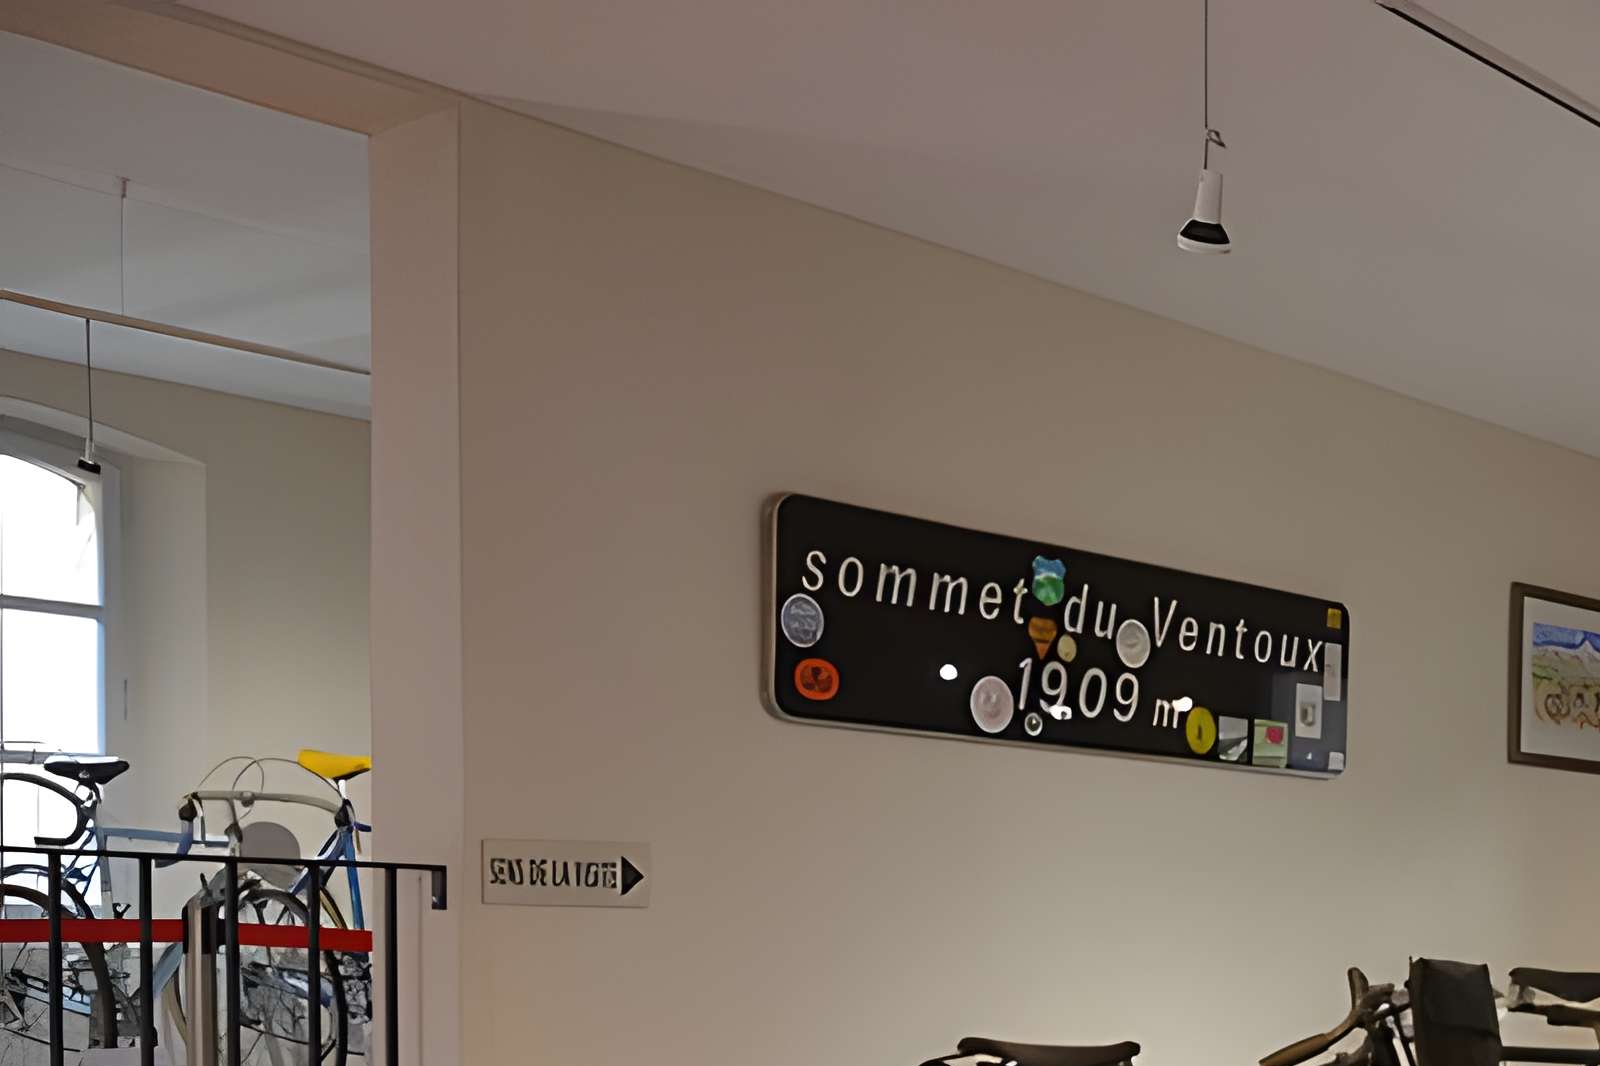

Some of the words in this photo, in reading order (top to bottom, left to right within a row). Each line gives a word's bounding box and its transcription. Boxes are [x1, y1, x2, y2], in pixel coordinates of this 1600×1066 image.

[802, 550, 1028, 625] sommet
[1063, 584, 1117, 640] du
[1153, 596, 1323, 673] Ventoux
[1018, 657, 1140, 723] 1909
[1152, 698, 1192, 730] m
